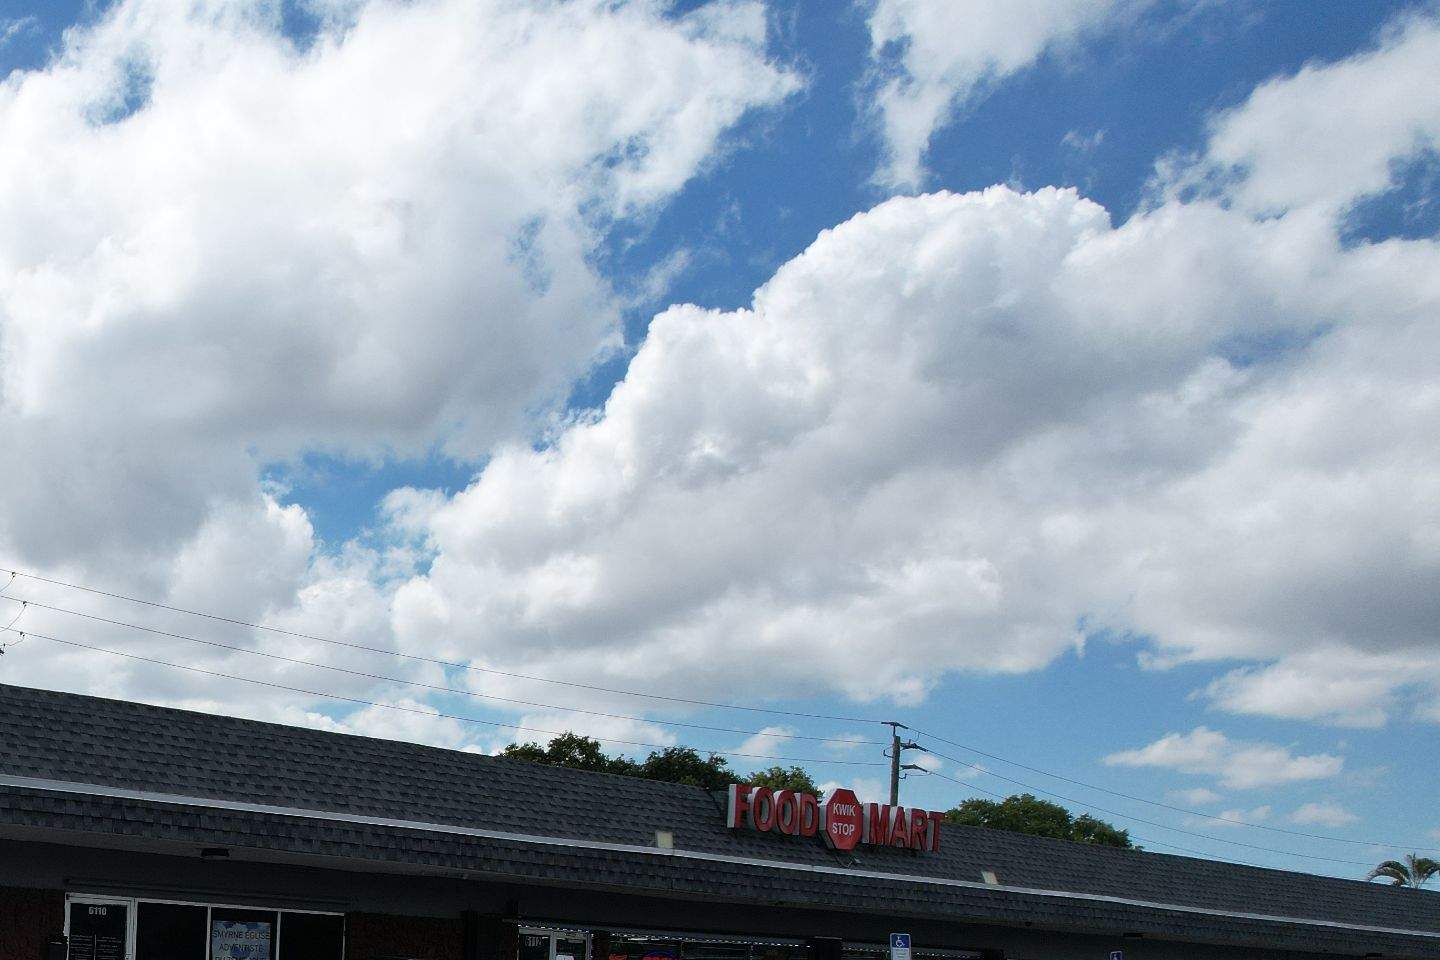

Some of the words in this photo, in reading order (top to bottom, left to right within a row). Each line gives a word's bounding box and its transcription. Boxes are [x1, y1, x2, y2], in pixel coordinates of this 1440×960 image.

[832, 802, 856, 817] KWIK
[731, 783, 819, 838] FOOD
[867, 802, 945, 853] MART
[832, 822, 856, 836] STOP
[88, 906, 107, 916] 6110
